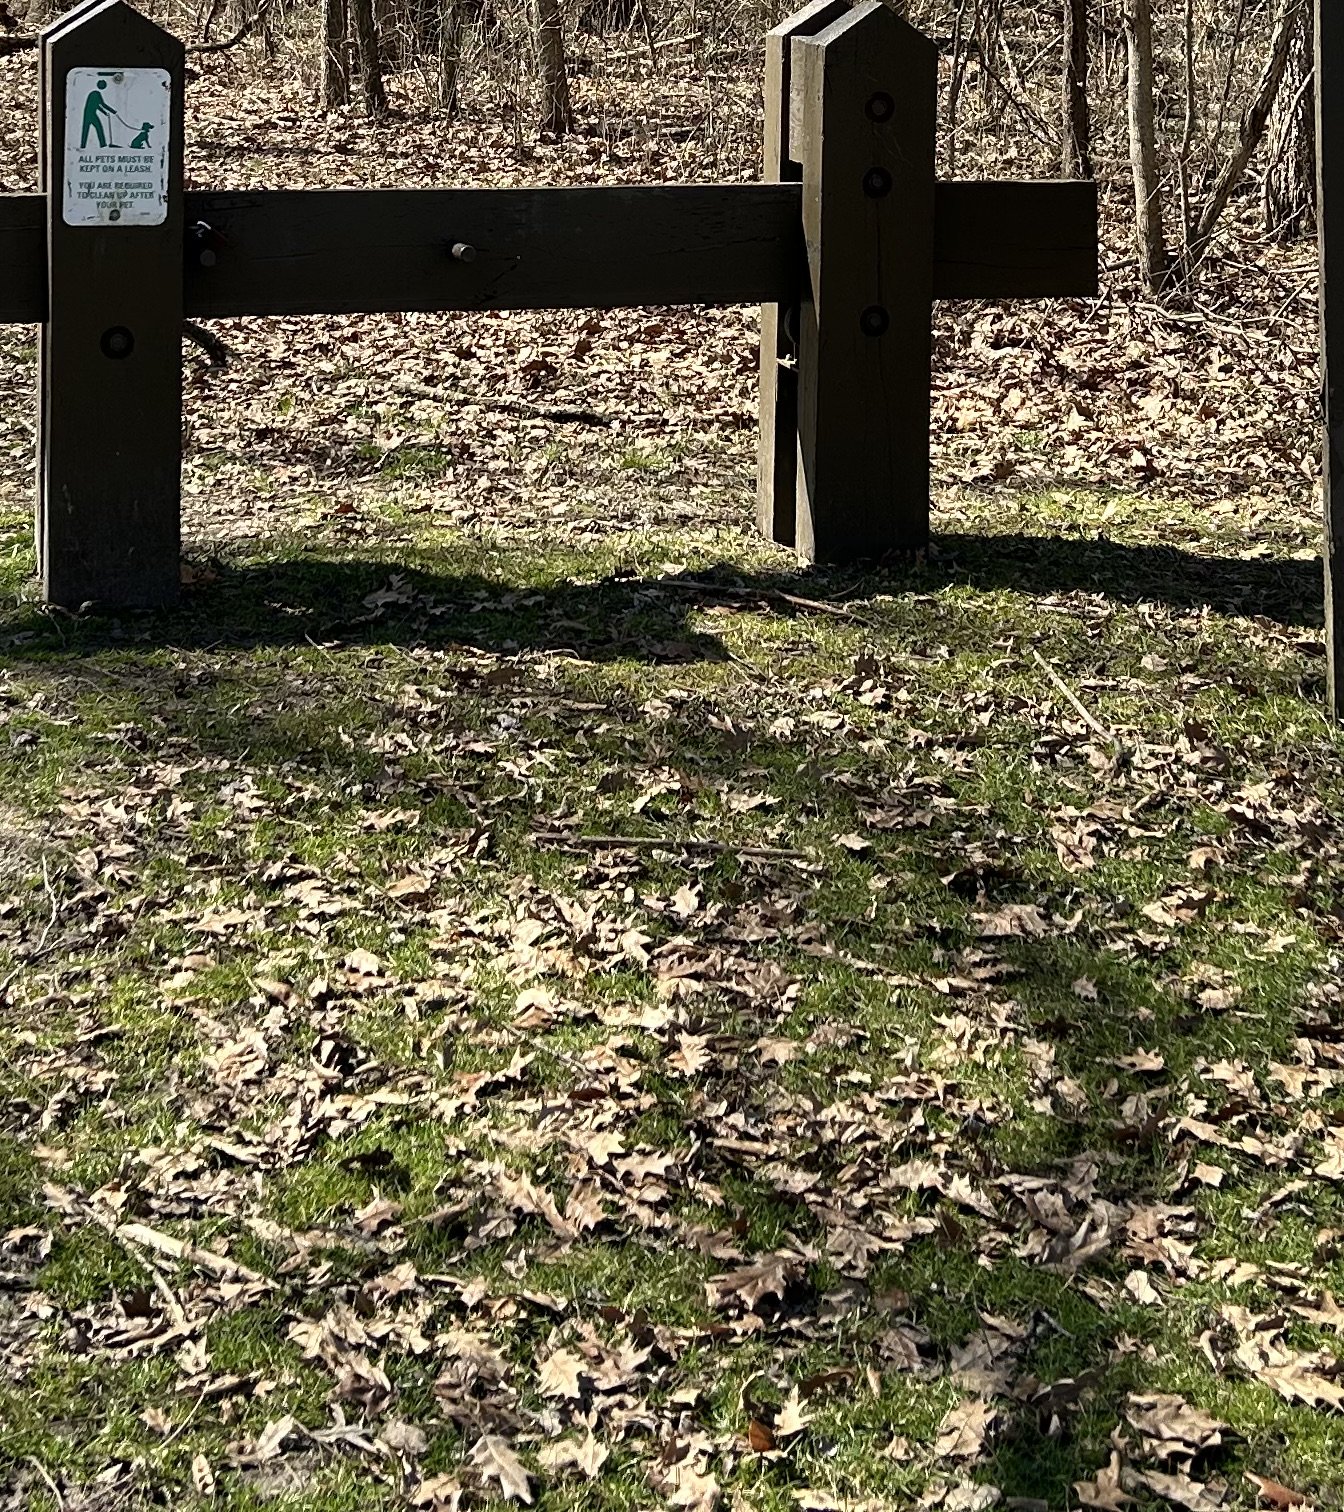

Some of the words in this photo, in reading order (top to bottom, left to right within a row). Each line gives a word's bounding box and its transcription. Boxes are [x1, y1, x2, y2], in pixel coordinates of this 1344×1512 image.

[78, 155, 93, 163] ALL
[95, 155, 116, 163] PETS
[118, 155, 141, 163] MUST
[144, 155, 154, 163] BE
[77, 191, 88, 199] TO
[89, 191, 114, 199] CLEAN
[116, 191, 128, 199] UP
[129, 191, 154, 199] AFTER
